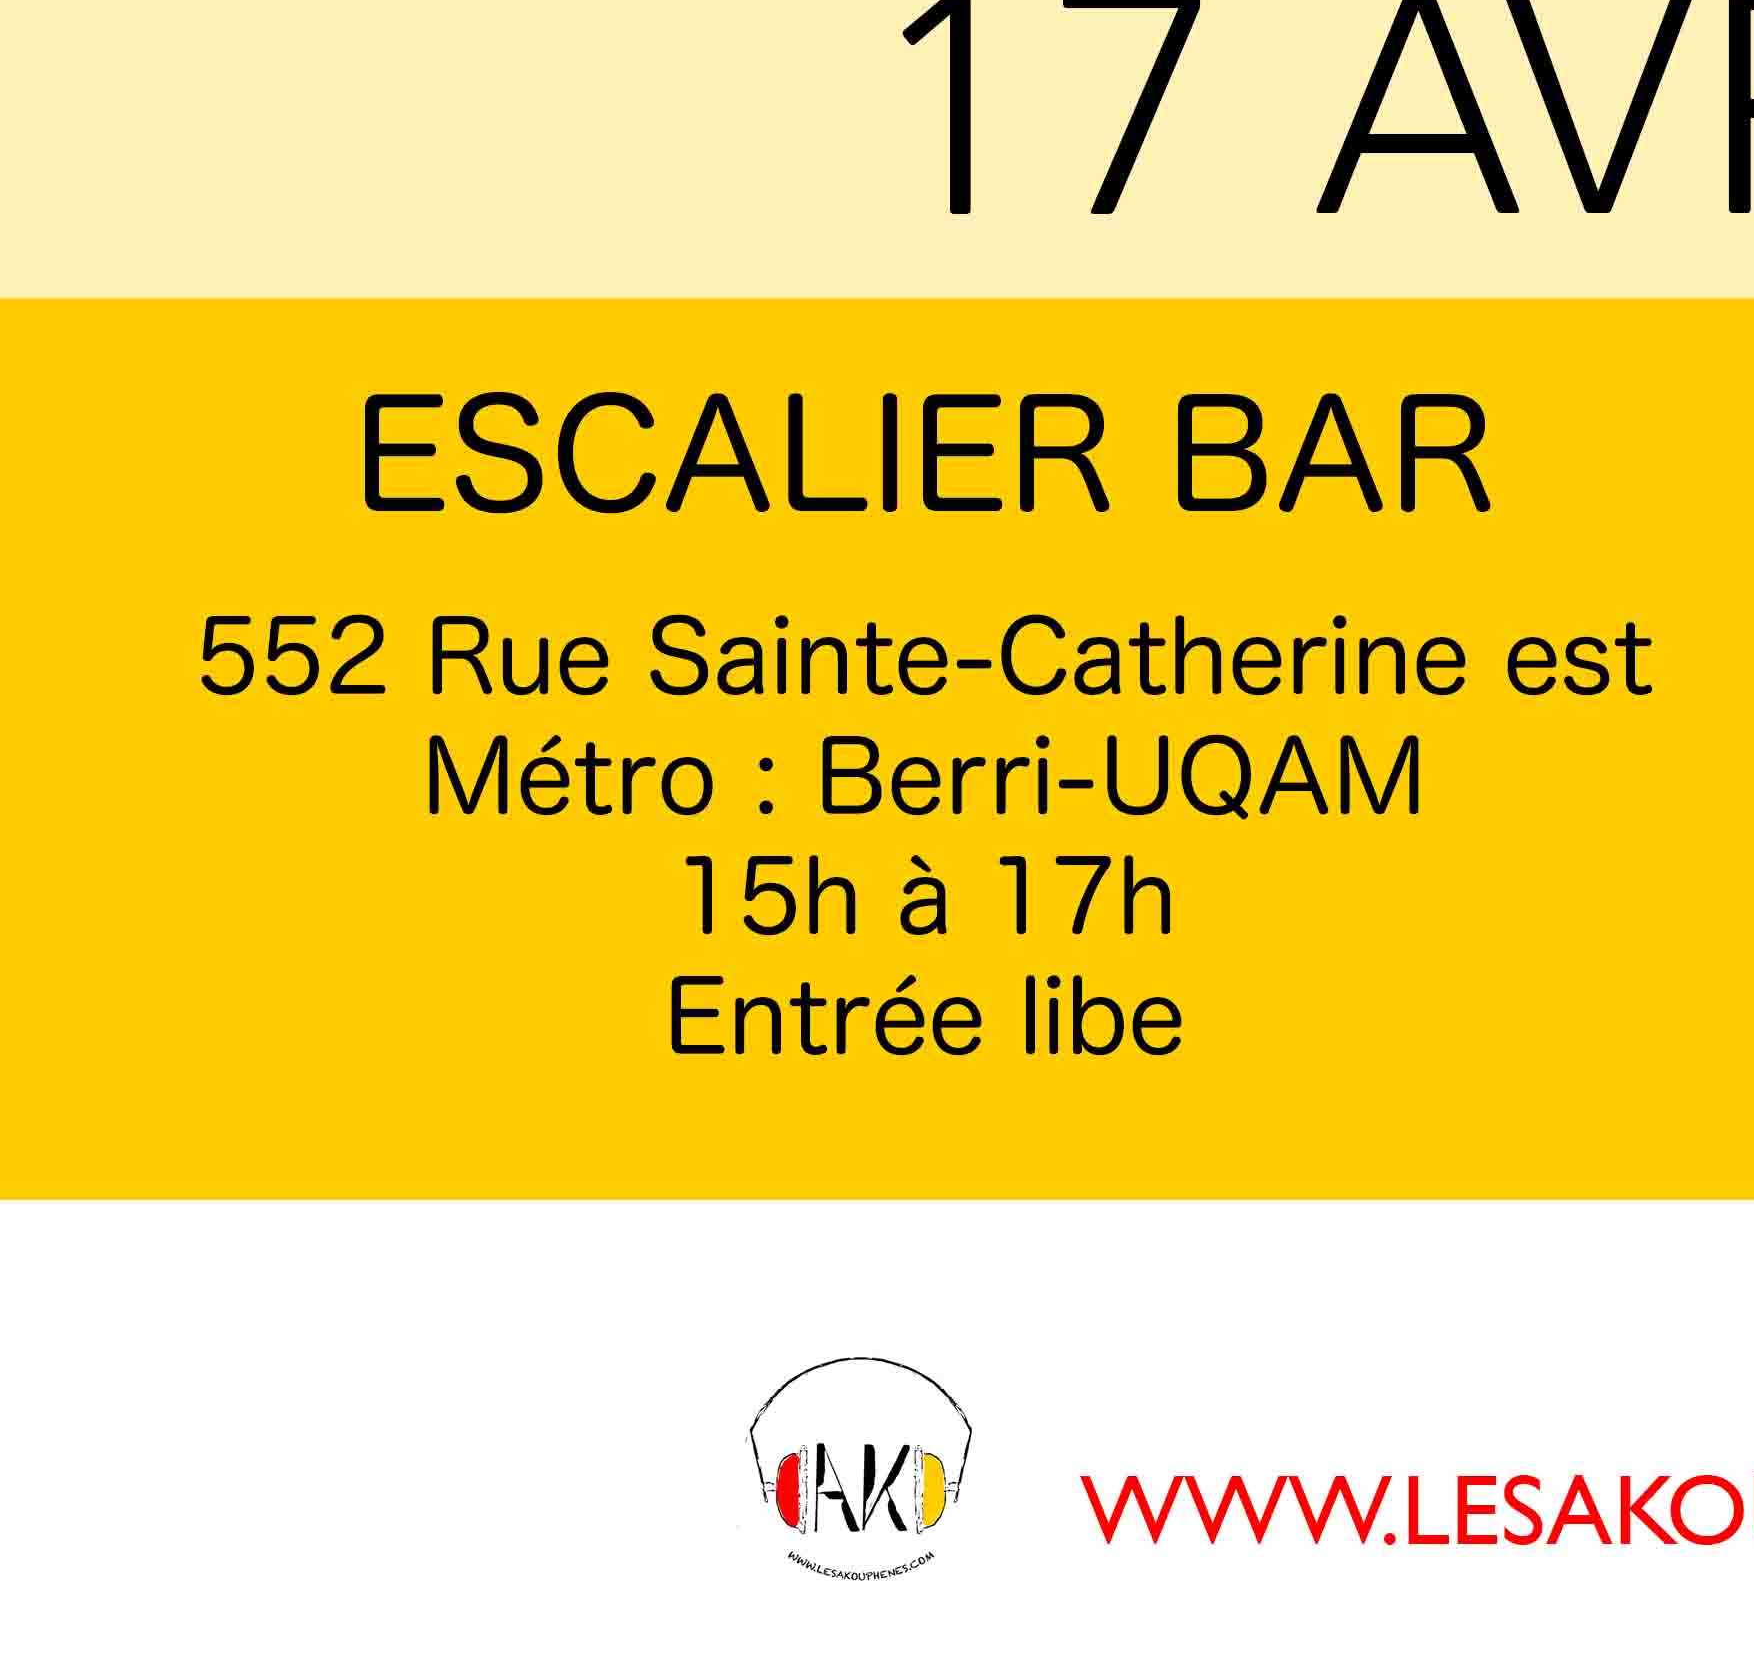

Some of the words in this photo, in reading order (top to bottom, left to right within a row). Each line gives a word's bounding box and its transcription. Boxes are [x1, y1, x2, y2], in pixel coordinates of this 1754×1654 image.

[364, 391, 1110, 514] ESCALIER
[1177, 392, 1491, 513] BAR
[200, 613, 387, 696] 552
[431, 615, 609, 696] Rue
[649, 613, 1467, 696] Sainte-Catherine
[1506, 621, 1653, 696] est
[428, 734, 714, 816] Métro
[821, 734, 1420, 821] Berri-UQAM
[685, 854, 856, 936] 15h
[899, 854, 948, 936] à
[999, 854, 1171, 935] 17h
[670, 973, 982, 1056] Entrée
[1025, 974, 1183, 1056] libe
